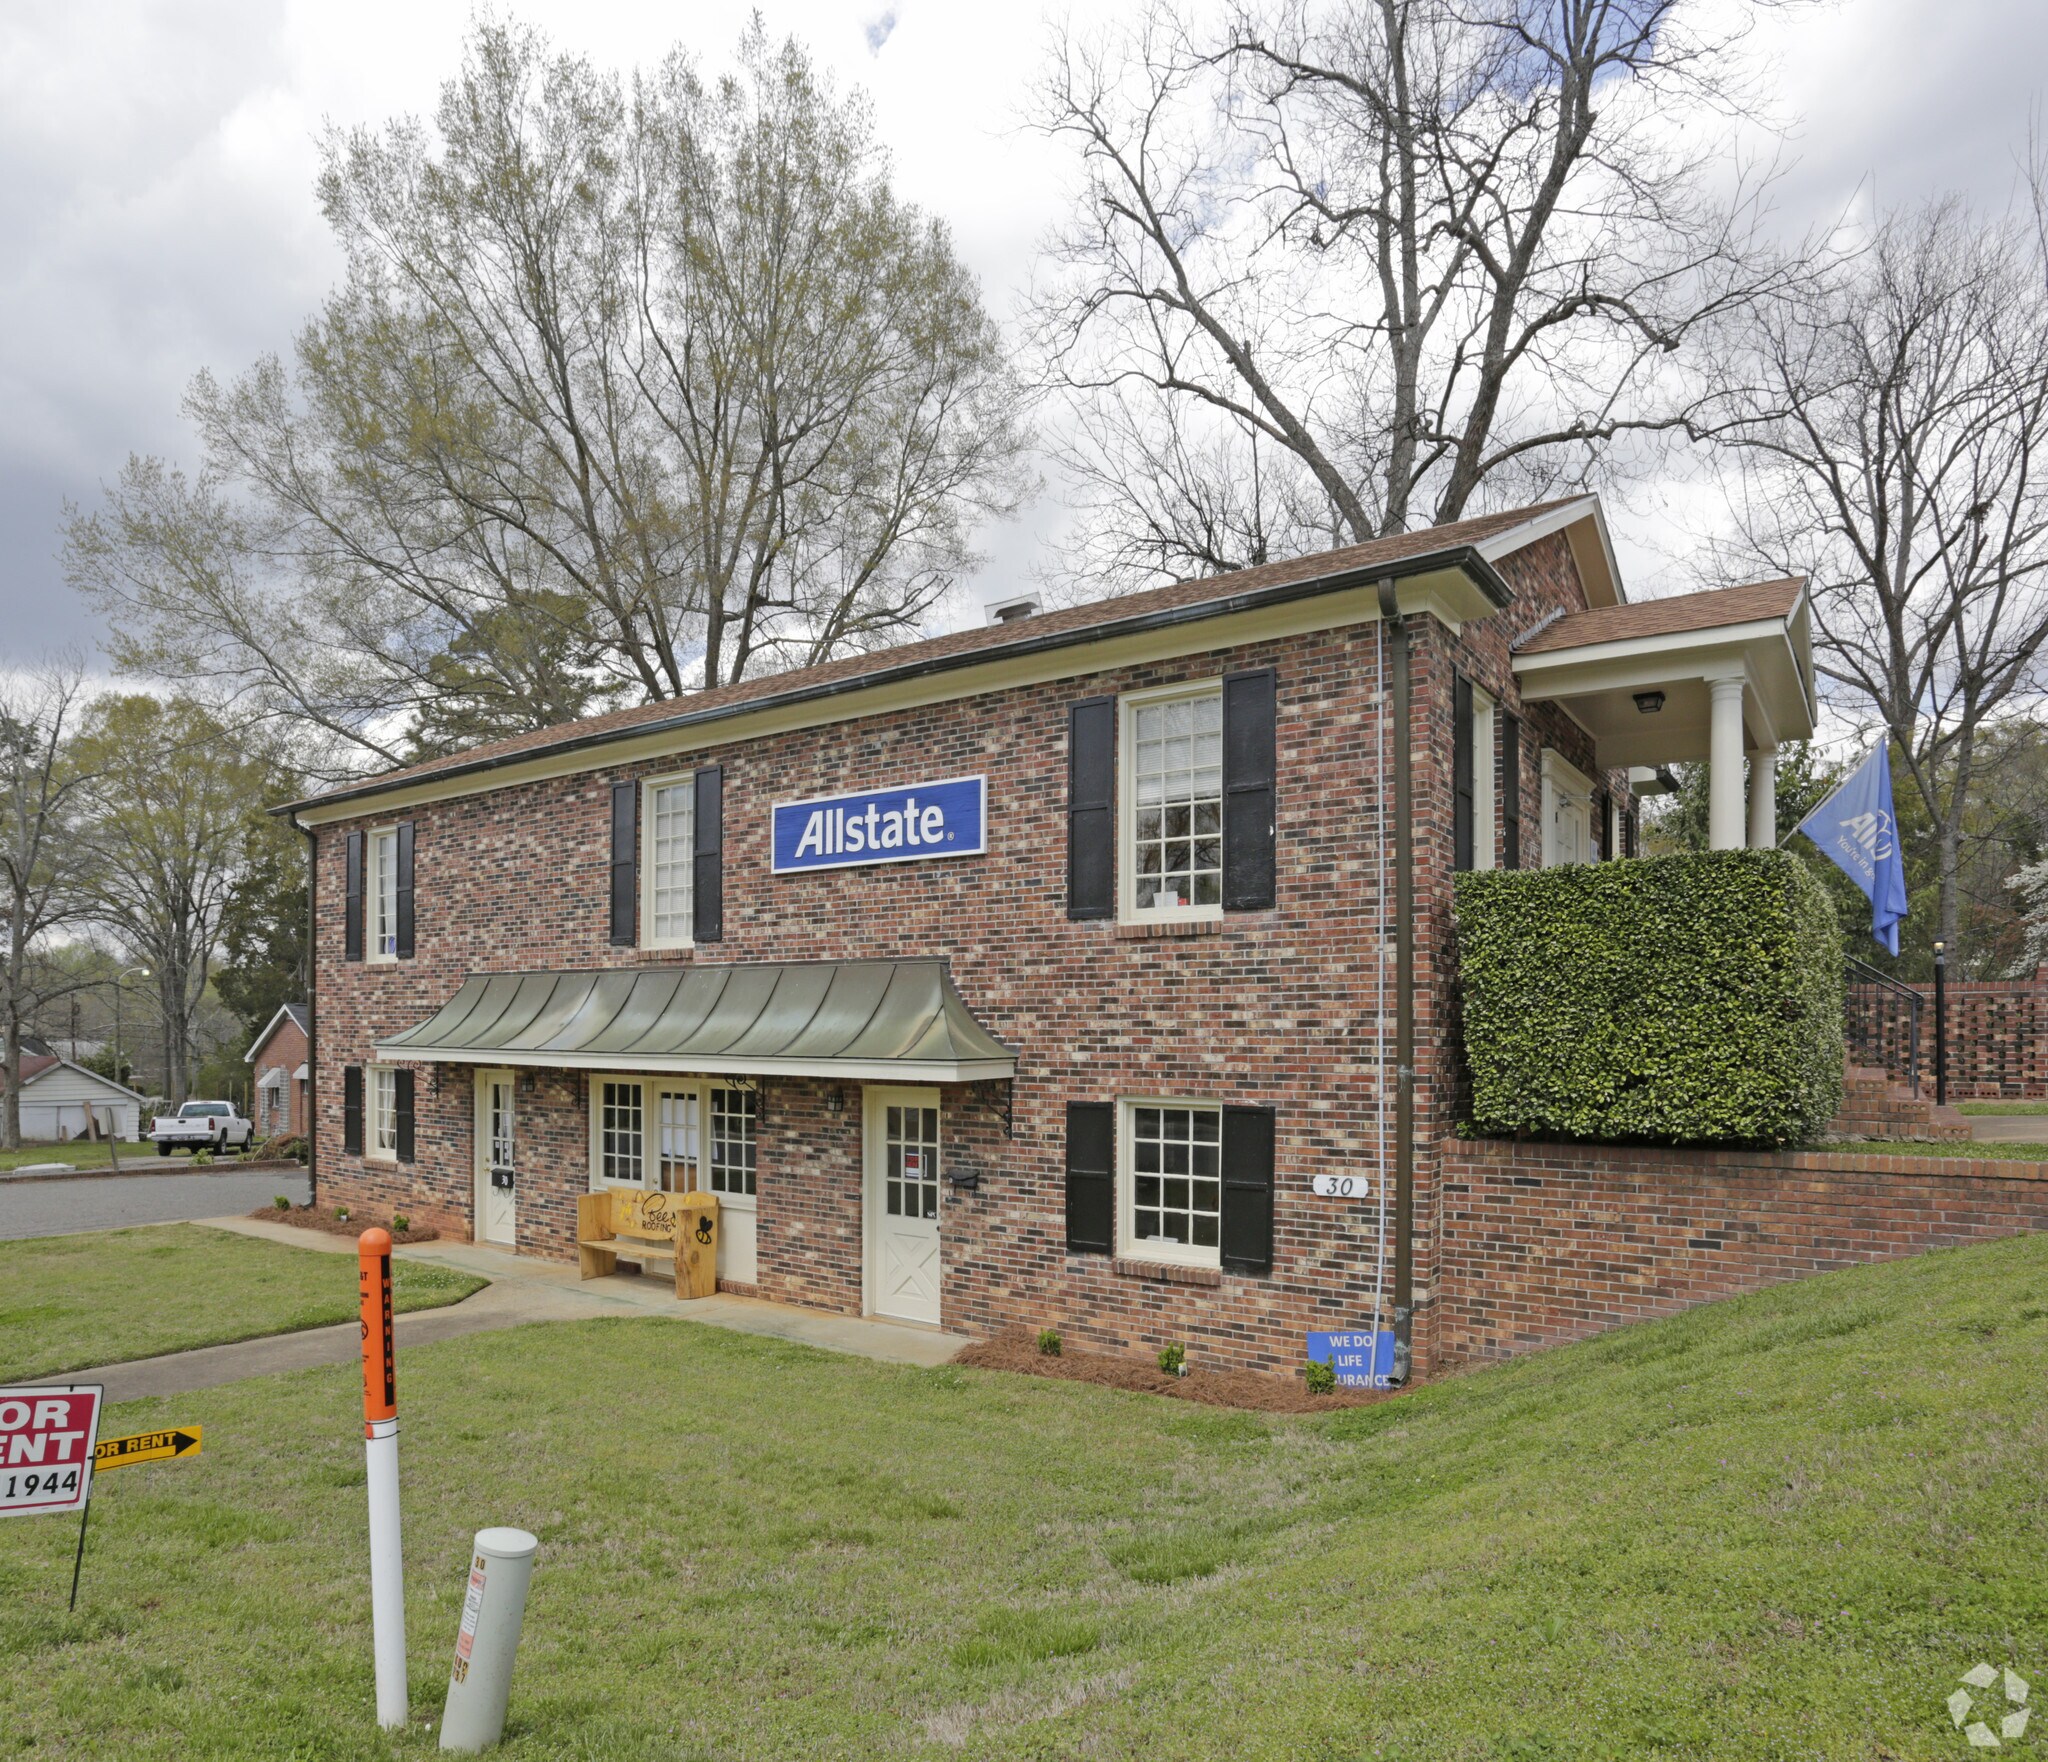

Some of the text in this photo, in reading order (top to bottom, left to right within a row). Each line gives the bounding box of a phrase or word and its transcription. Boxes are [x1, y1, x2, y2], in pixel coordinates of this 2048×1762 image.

[794, 798, 944, 858] Allstate
[1326, 1177, 1353, 1196] 30
[642, 1220, 672, 1233] ROOFING
[382, 1278, 392, 1383] WARNING
[1329, 1335, 1373, 1348] WE DO
[1338, 1355, 1363, 1367] LIFE
[0, 1400, 71, 1431] OR
[95, 1433, 176, 1459] OR RENT
[6, 1470, 78, 1498] 1944
